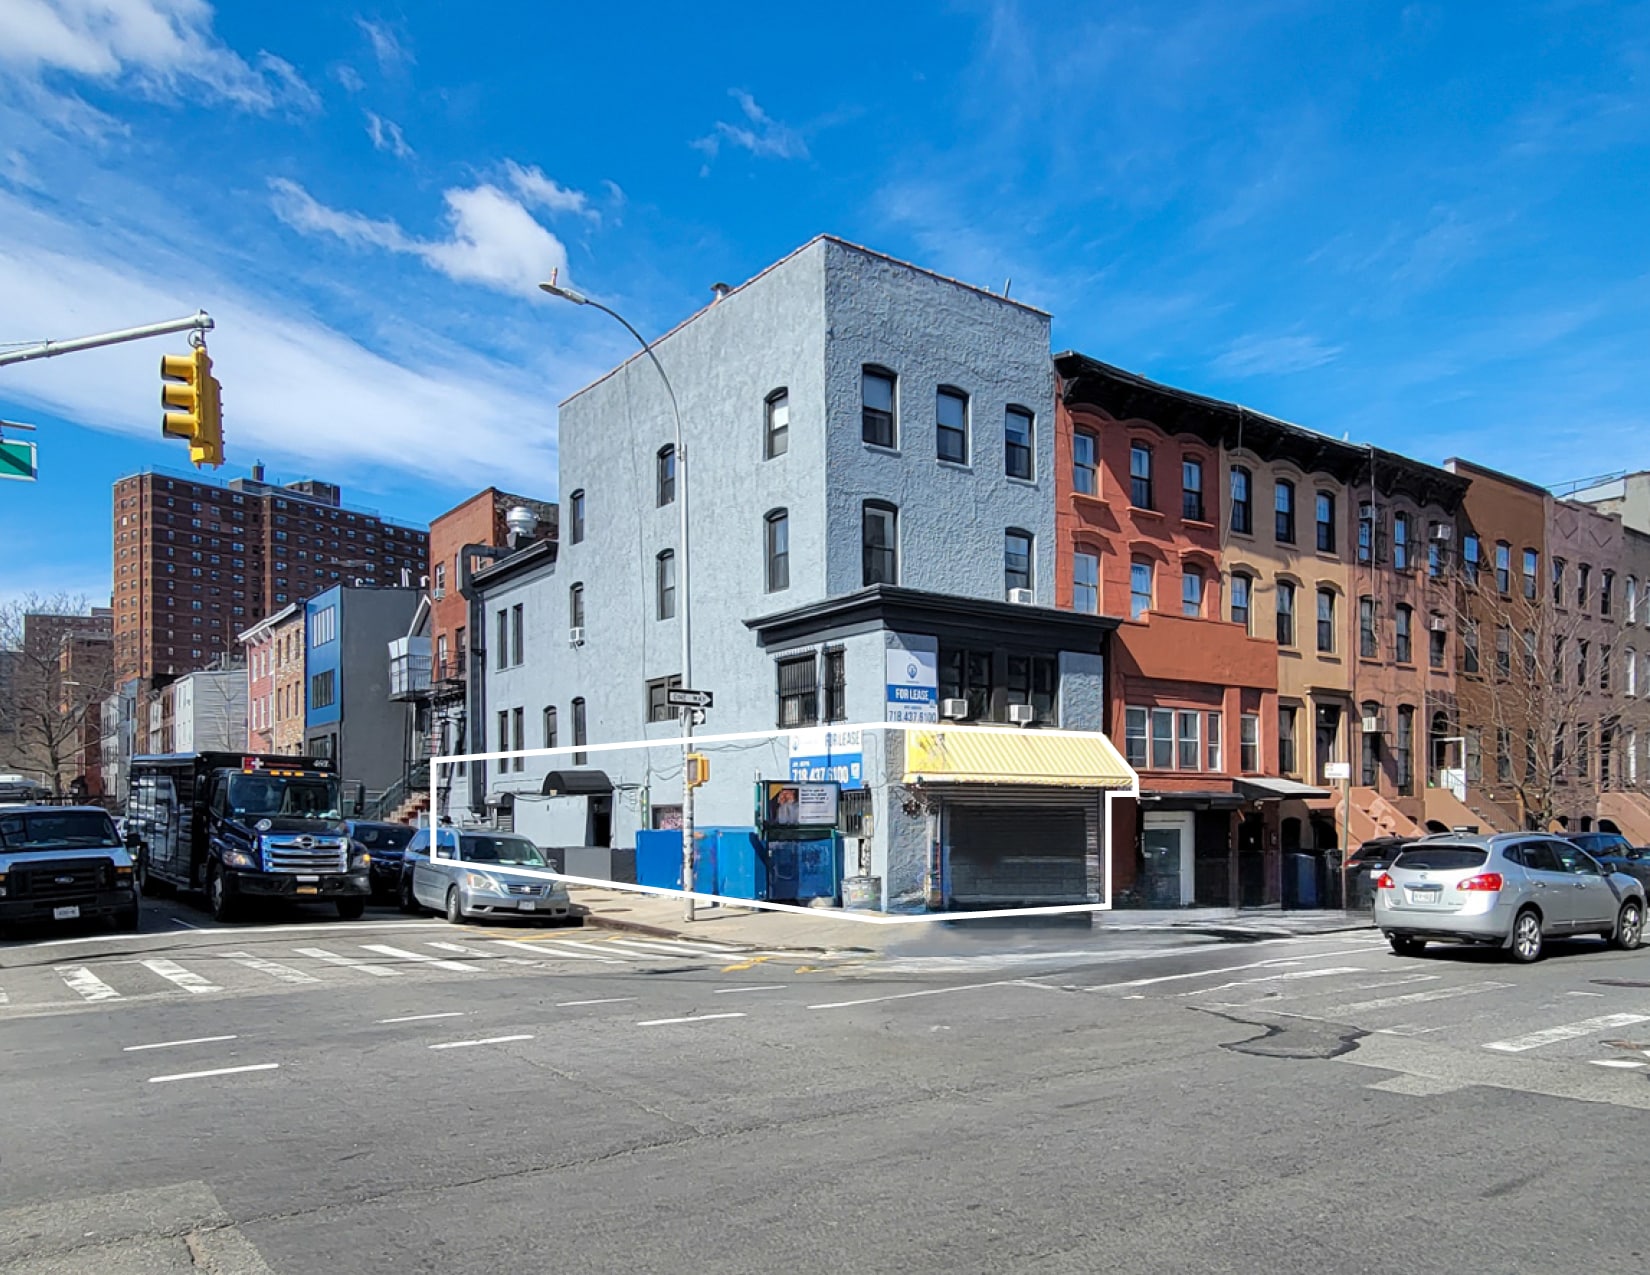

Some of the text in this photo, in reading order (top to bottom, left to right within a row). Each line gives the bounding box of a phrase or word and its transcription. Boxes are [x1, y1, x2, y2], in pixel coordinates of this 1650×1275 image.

[673, 693, 706, 703] ONE WAY
[895, 687, 929, 701] FOR LEASE
[825, 730, 860, 748] FOR LEASE
